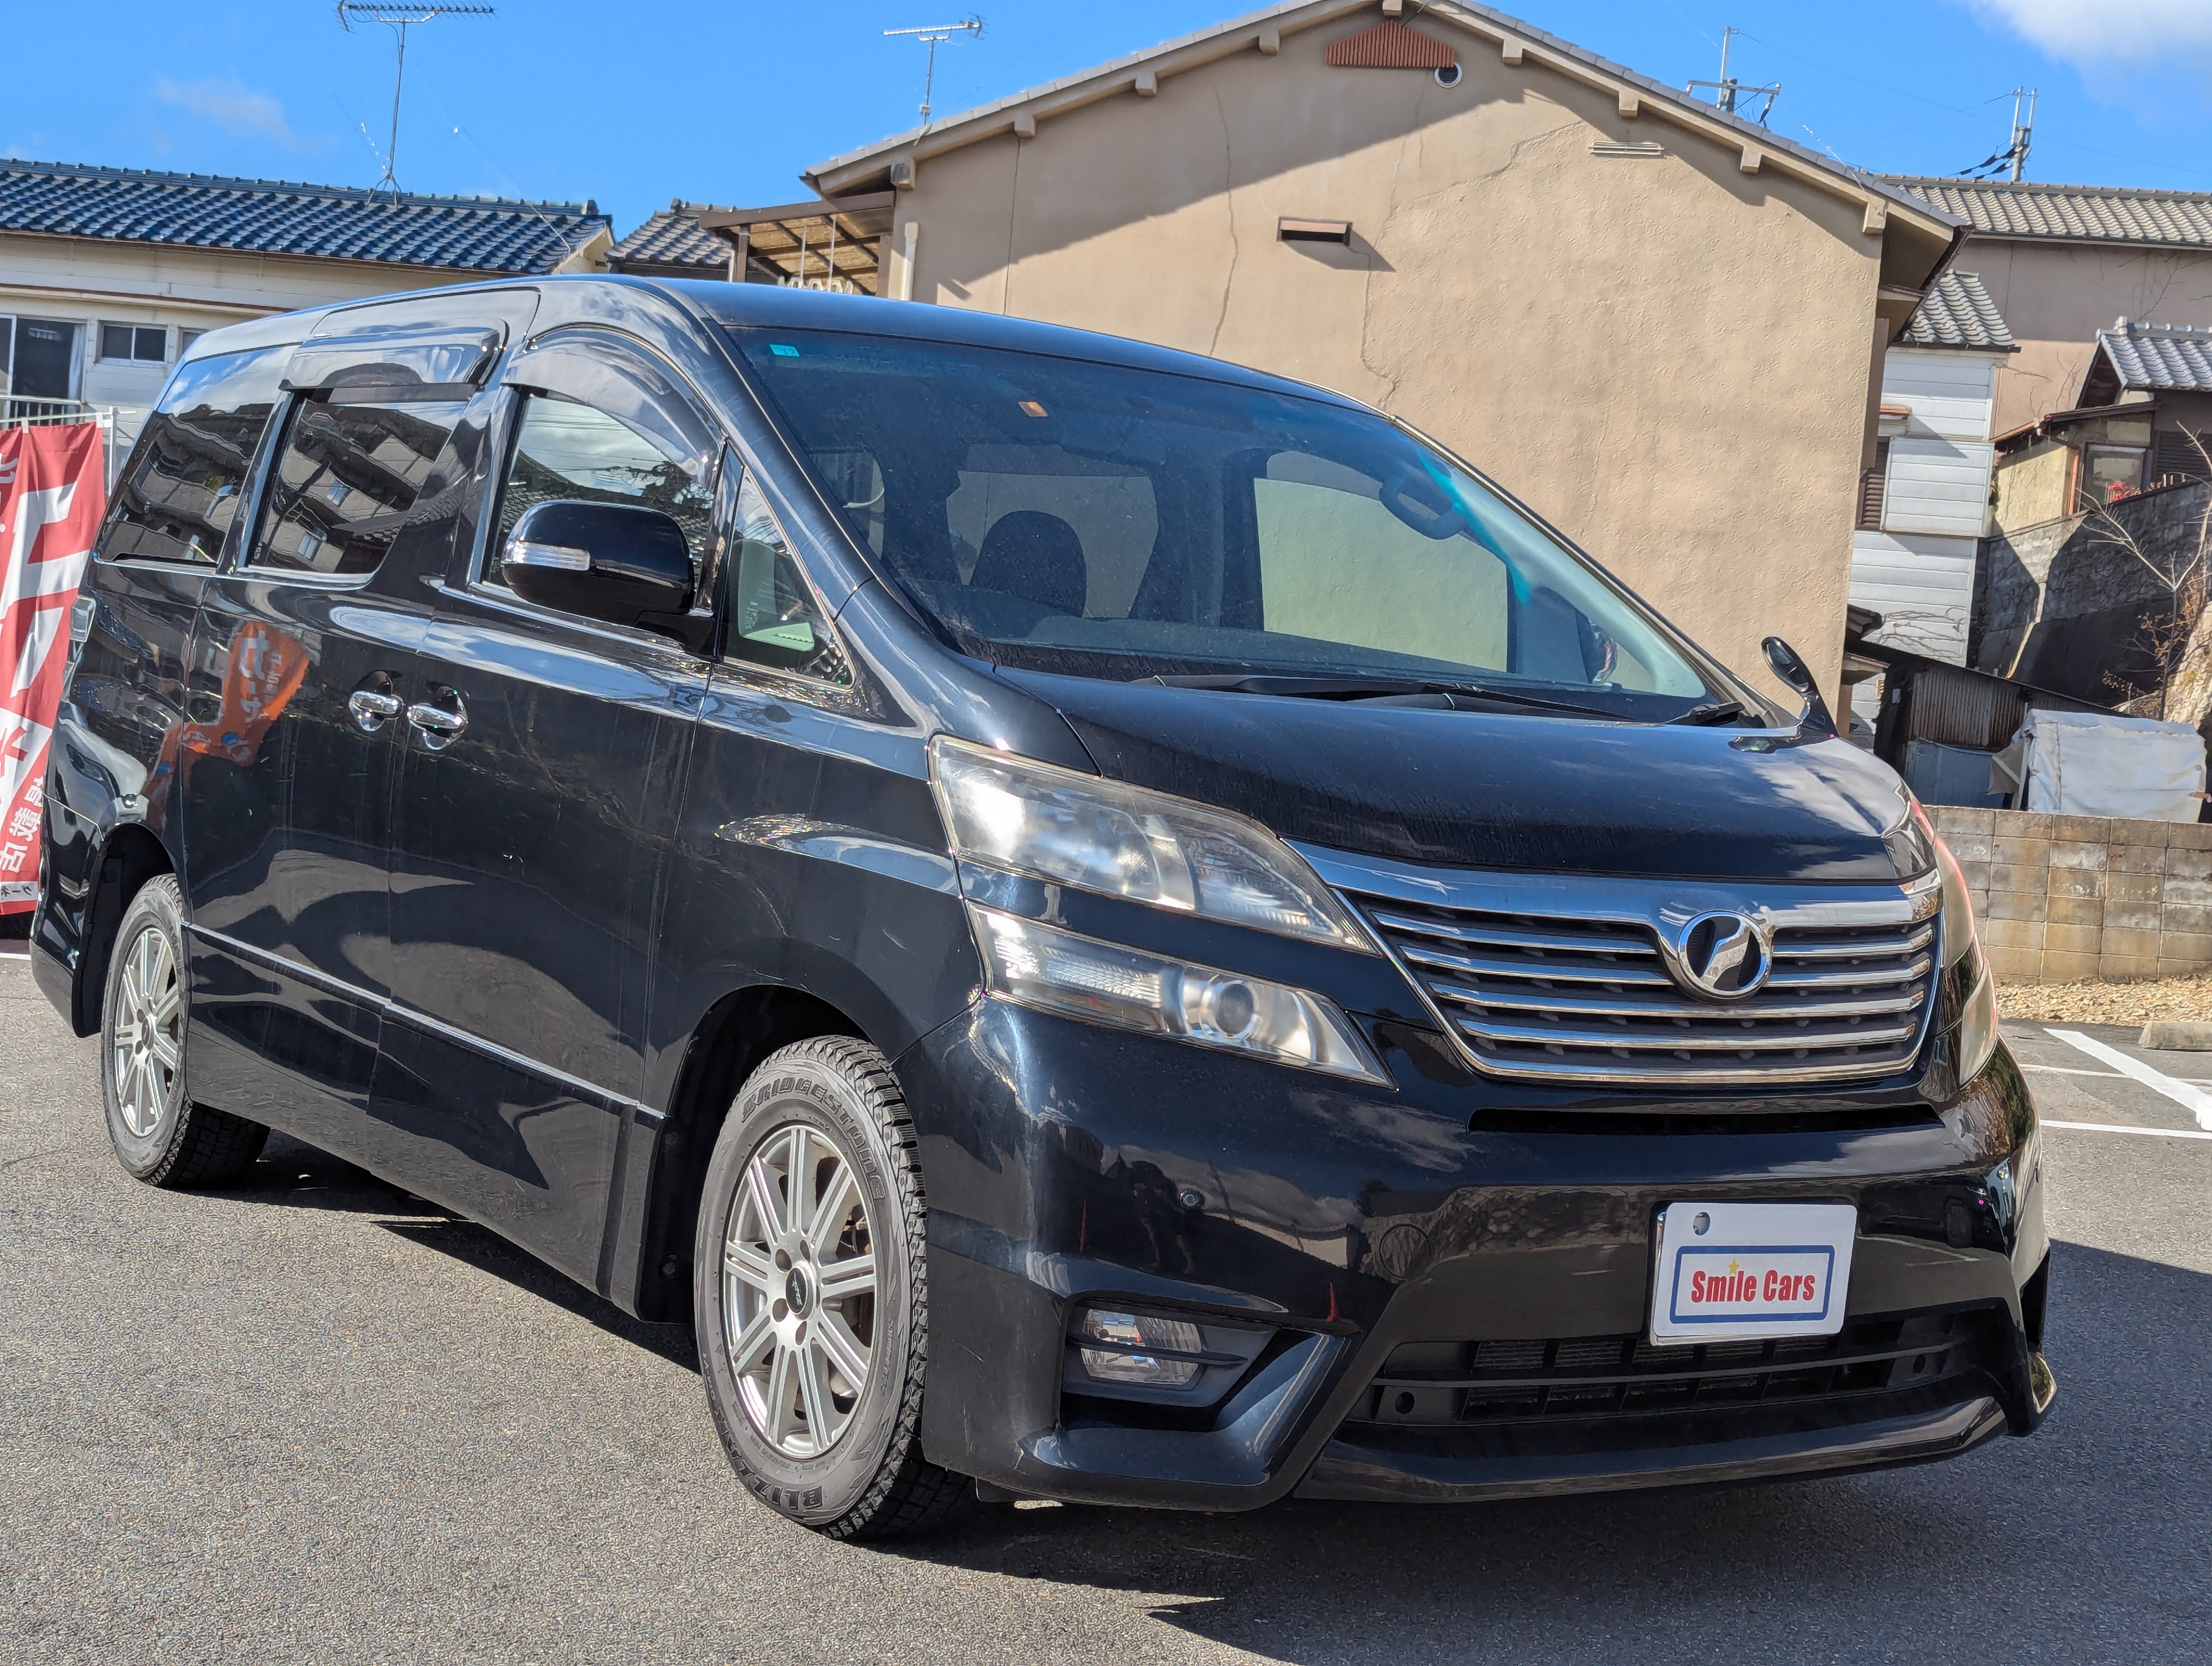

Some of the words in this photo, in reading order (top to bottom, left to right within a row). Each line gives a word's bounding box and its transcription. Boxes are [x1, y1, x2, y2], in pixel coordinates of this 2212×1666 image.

[741, 1077, 886, 1201] BRIDGESTONE
[1691, 1270, 1757, 1303] Smile
[1763, 1270, 1815, 1302] Cars
[714, 1406, 823, 1511] BLIZZAK
